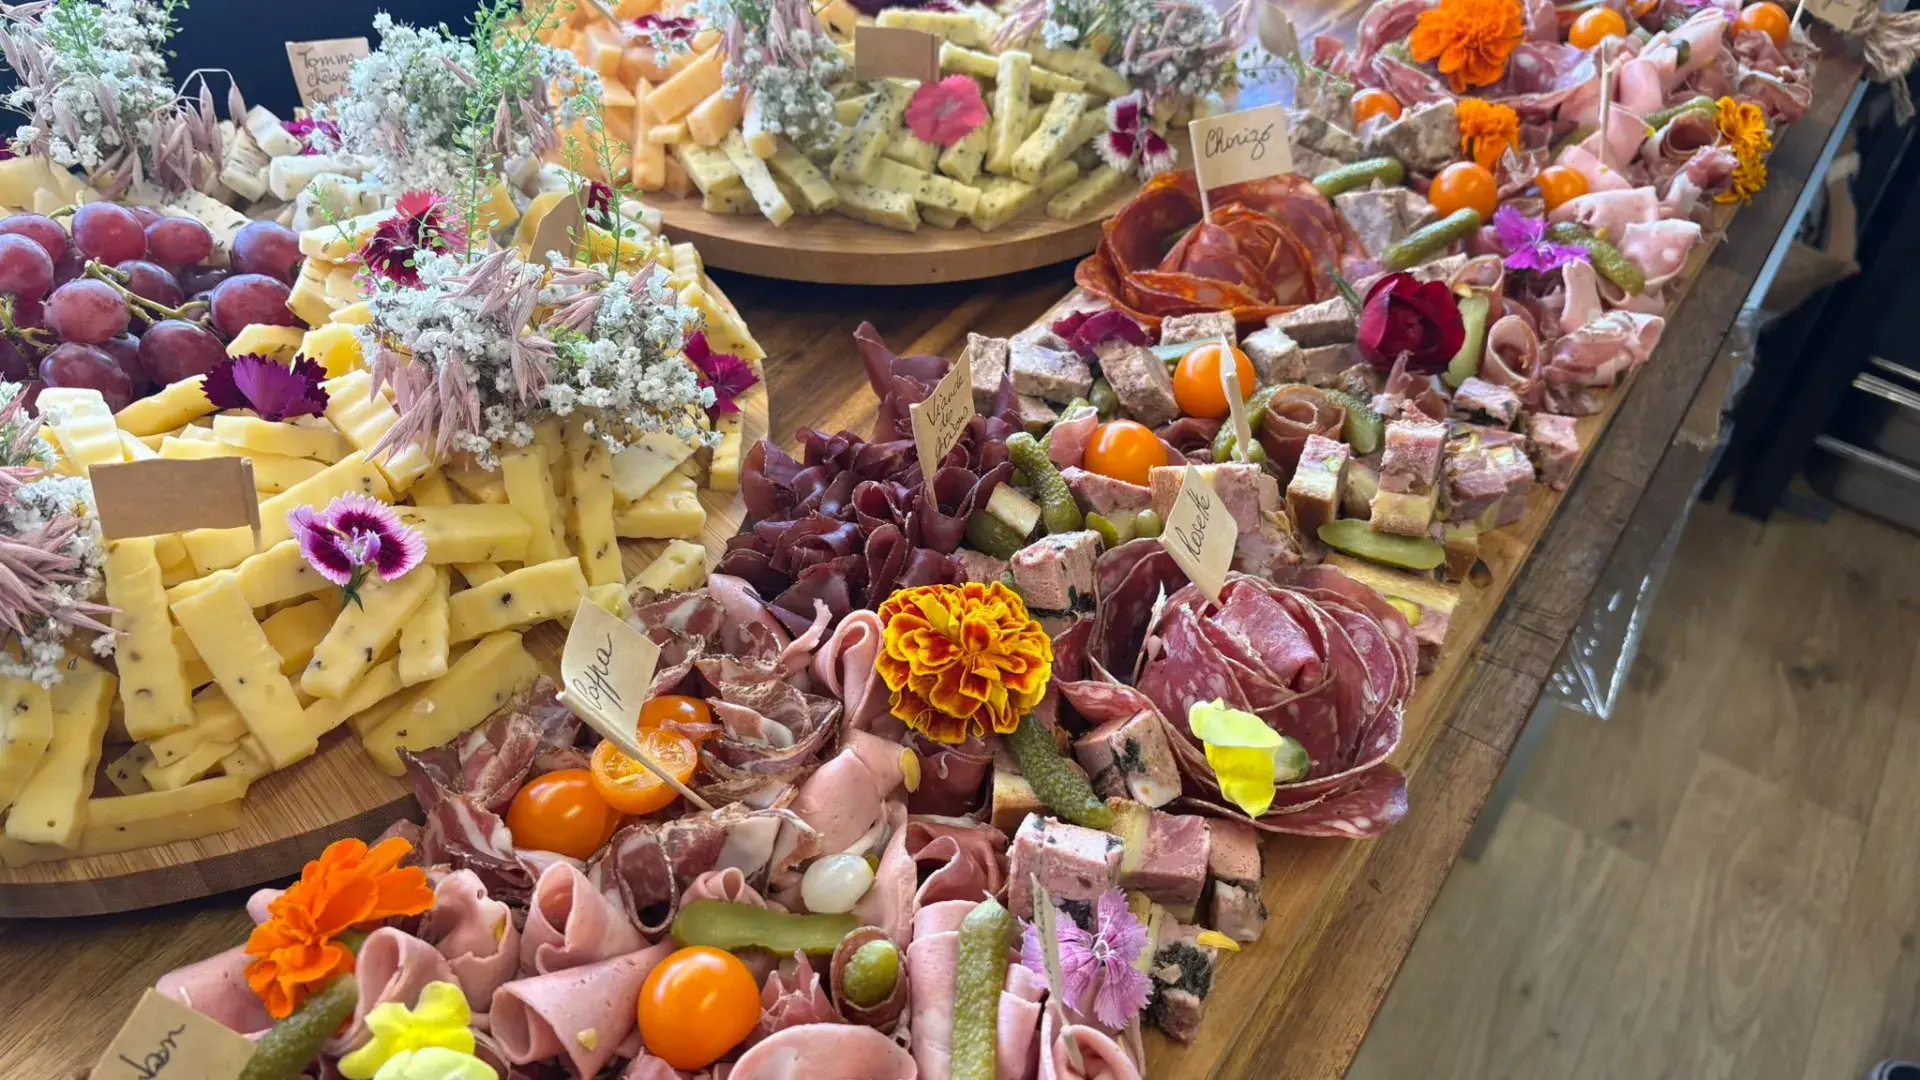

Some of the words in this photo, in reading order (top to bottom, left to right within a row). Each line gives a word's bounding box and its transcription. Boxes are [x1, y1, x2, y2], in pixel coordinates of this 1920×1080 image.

[1205, 123, 1274, 161] Chorizo
[926, 370, 965, 426] Viande
[1174, 487, 1211, 564] Rosette
[572, 633, 624, 711] Coppa
